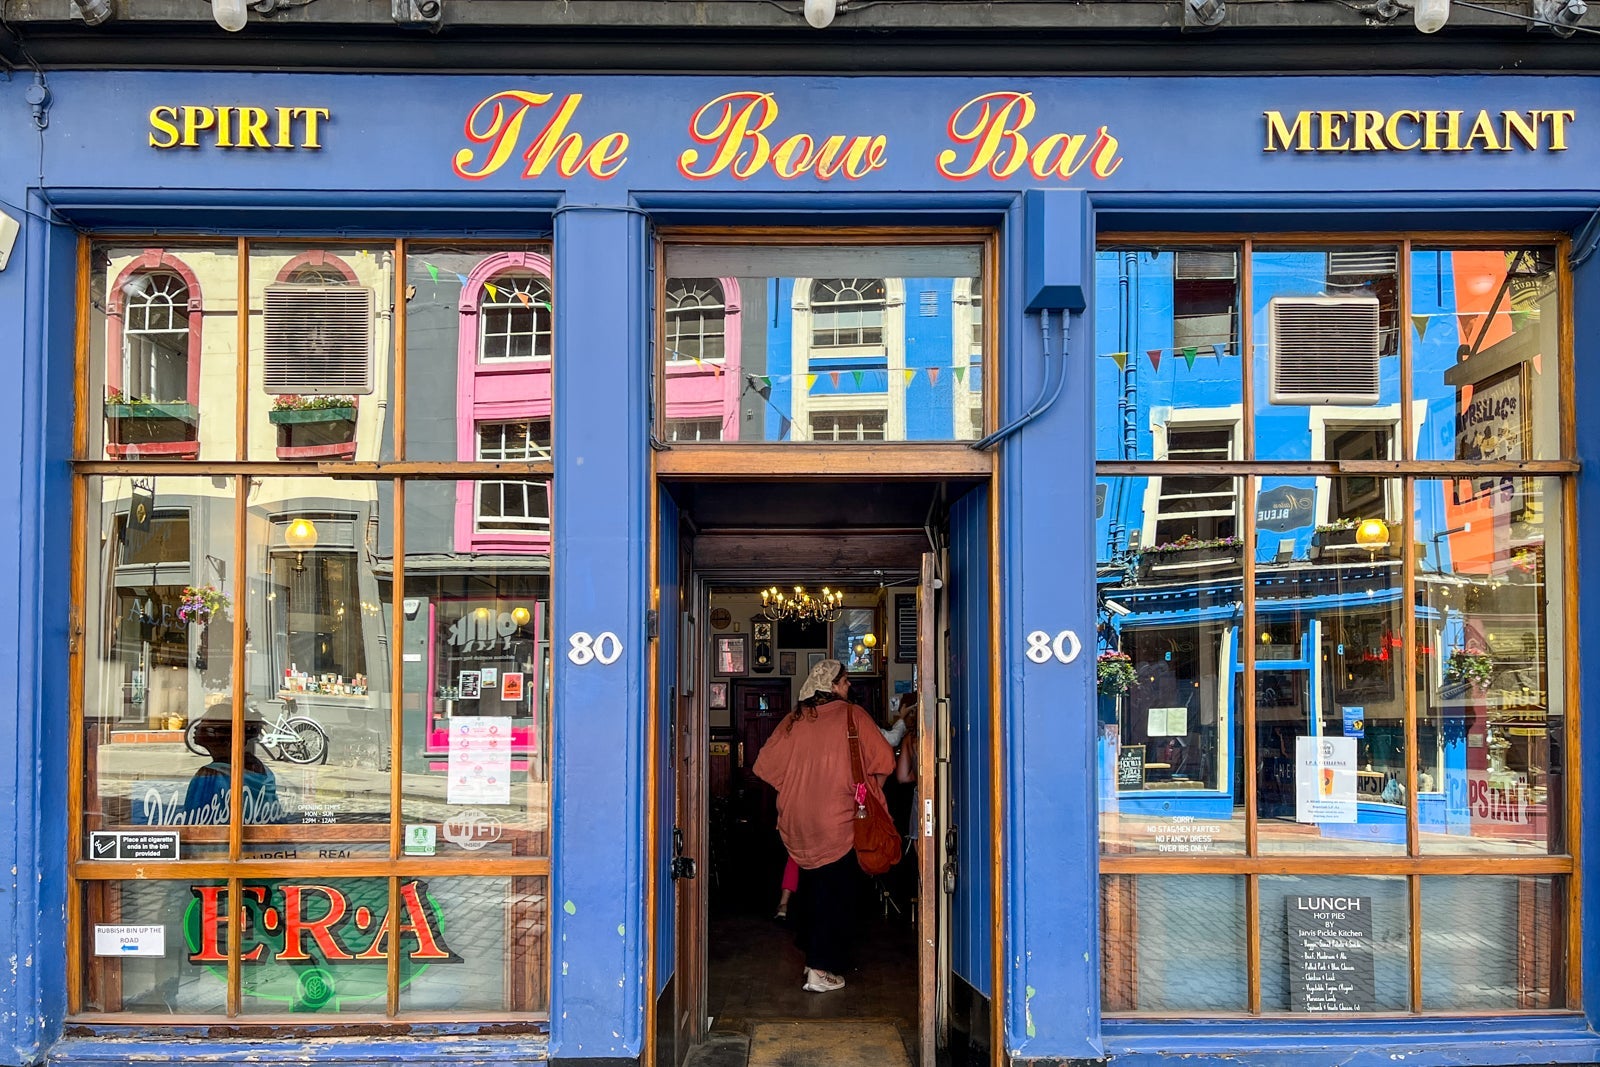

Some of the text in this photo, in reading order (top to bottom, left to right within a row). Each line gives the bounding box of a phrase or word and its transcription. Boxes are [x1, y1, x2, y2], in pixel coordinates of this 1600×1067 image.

[148, 105, 330, 149] SPIRIT
[452, 89, 1124, 182] The Bow Bar
[1262, 109, 1575, 153] MERCHANT
[568, 631, 624, 667] 80
[1025, 629, 1082, 665] 80
[135, 850, 160, 858] provided
[148, 836, 174, 844] cigarette
[1298, 898, 1360, 910] LUNCH
[1314, 912, 1346, 920] HOT PIES
